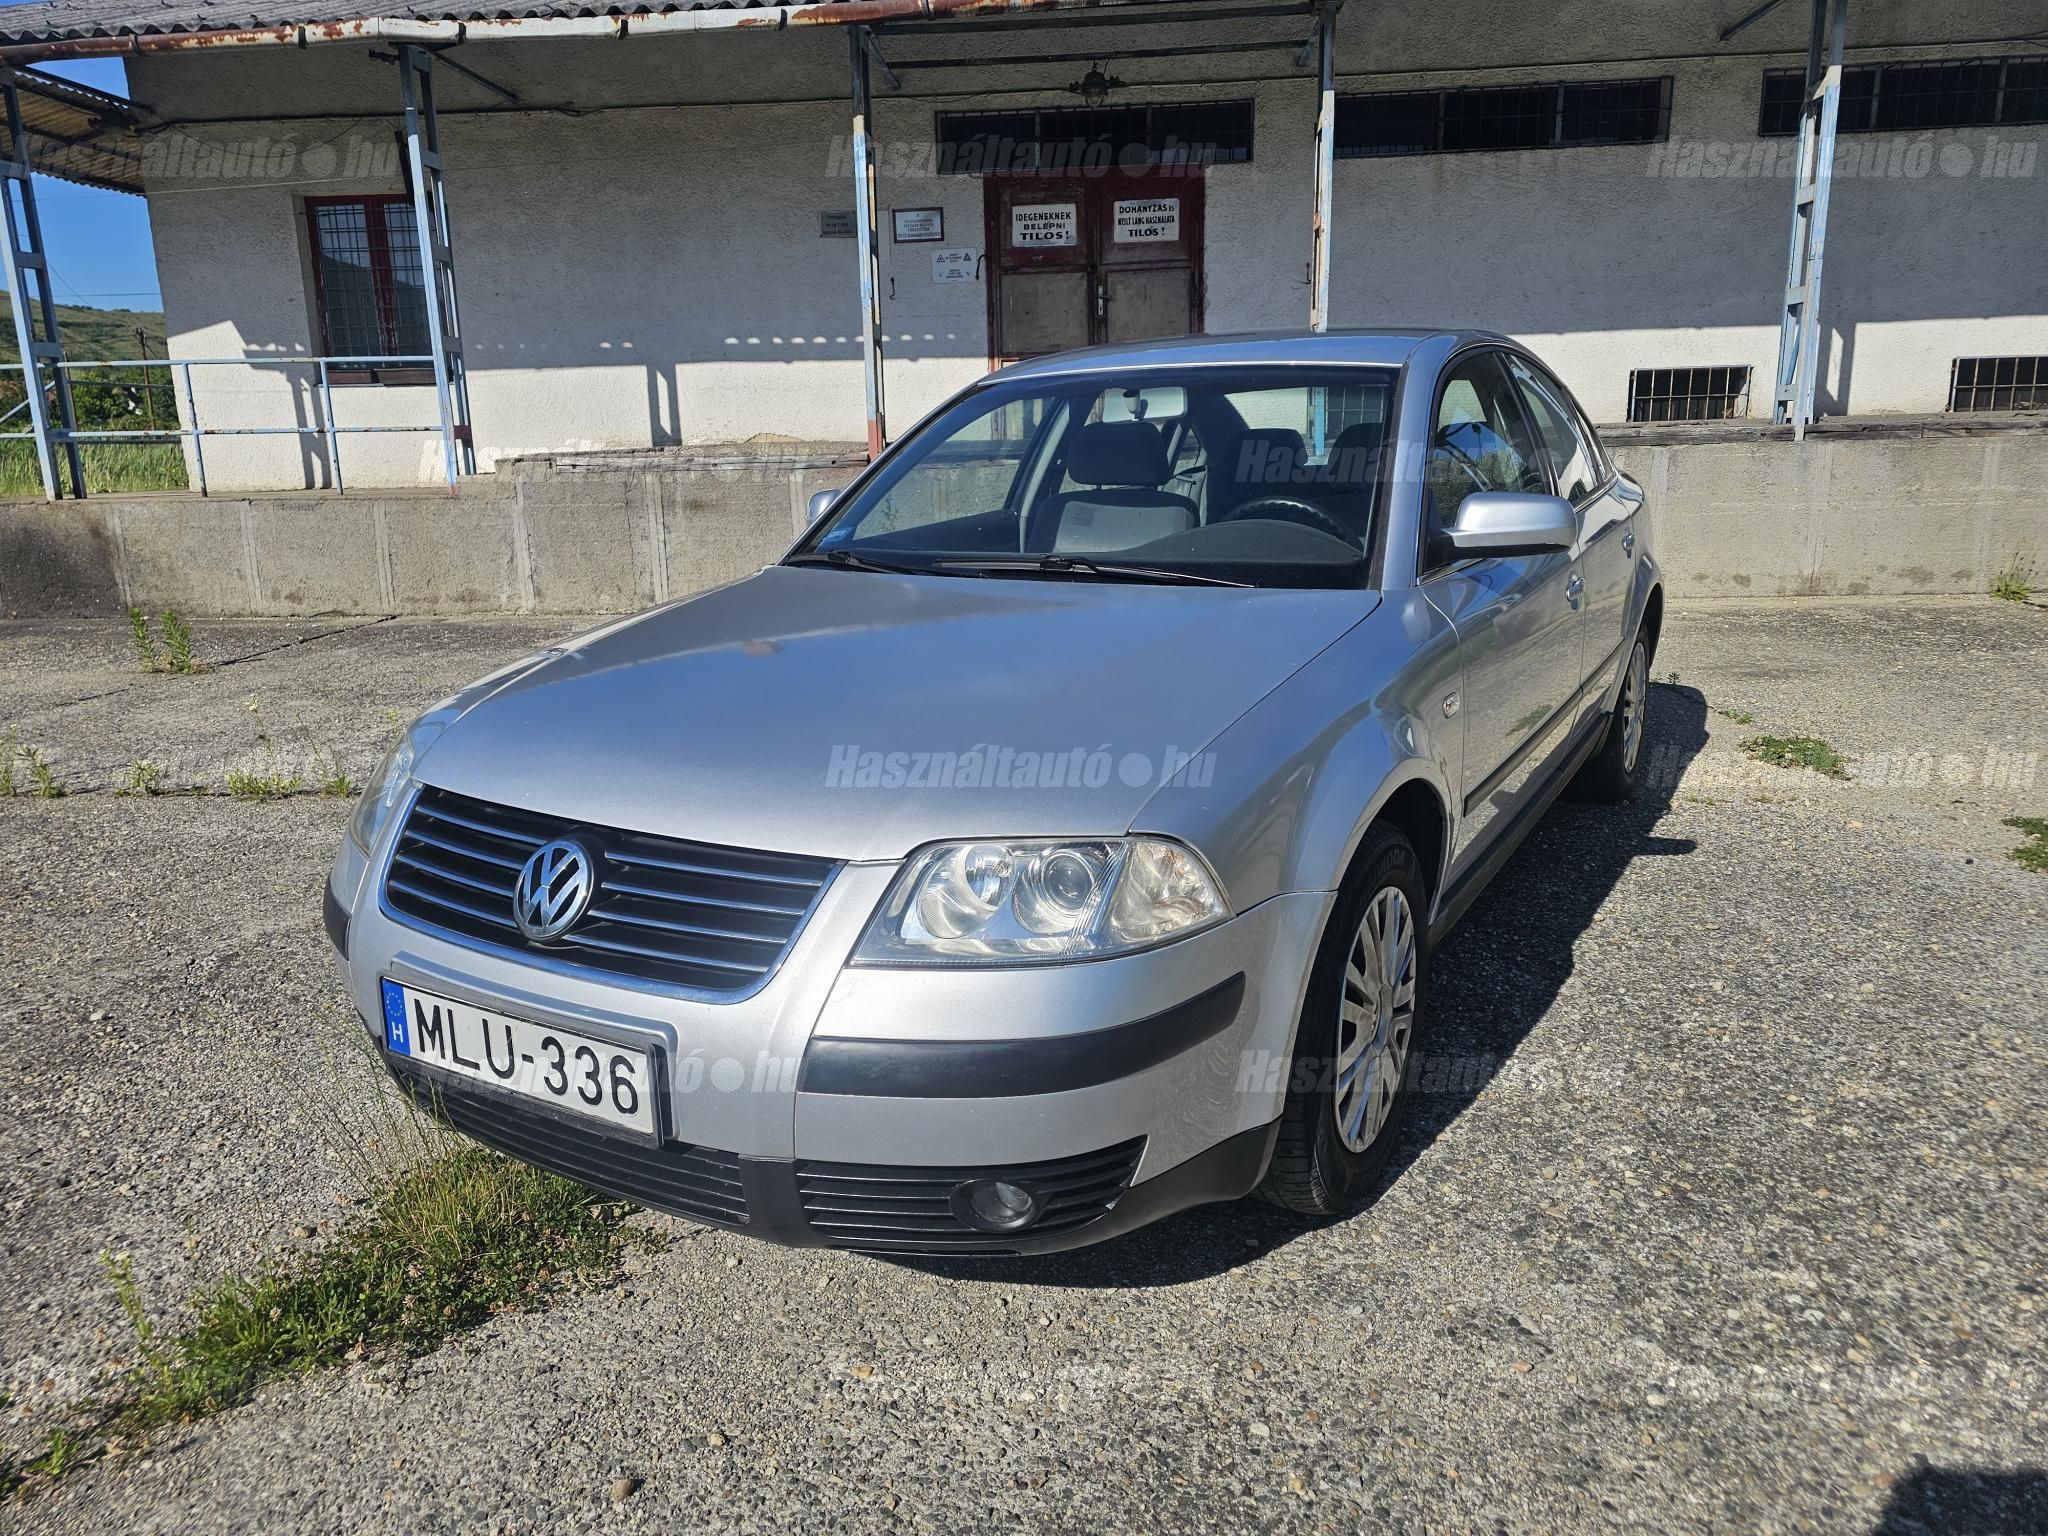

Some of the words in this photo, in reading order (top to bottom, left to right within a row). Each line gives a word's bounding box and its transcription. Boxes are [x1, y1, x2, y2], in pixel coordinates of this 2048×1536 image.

[1015, 211, 1072, 222] IDEGENEKNEK
[392, 1022, 404, 1044] H
[414, 998, 639, 1115] MLU-336
